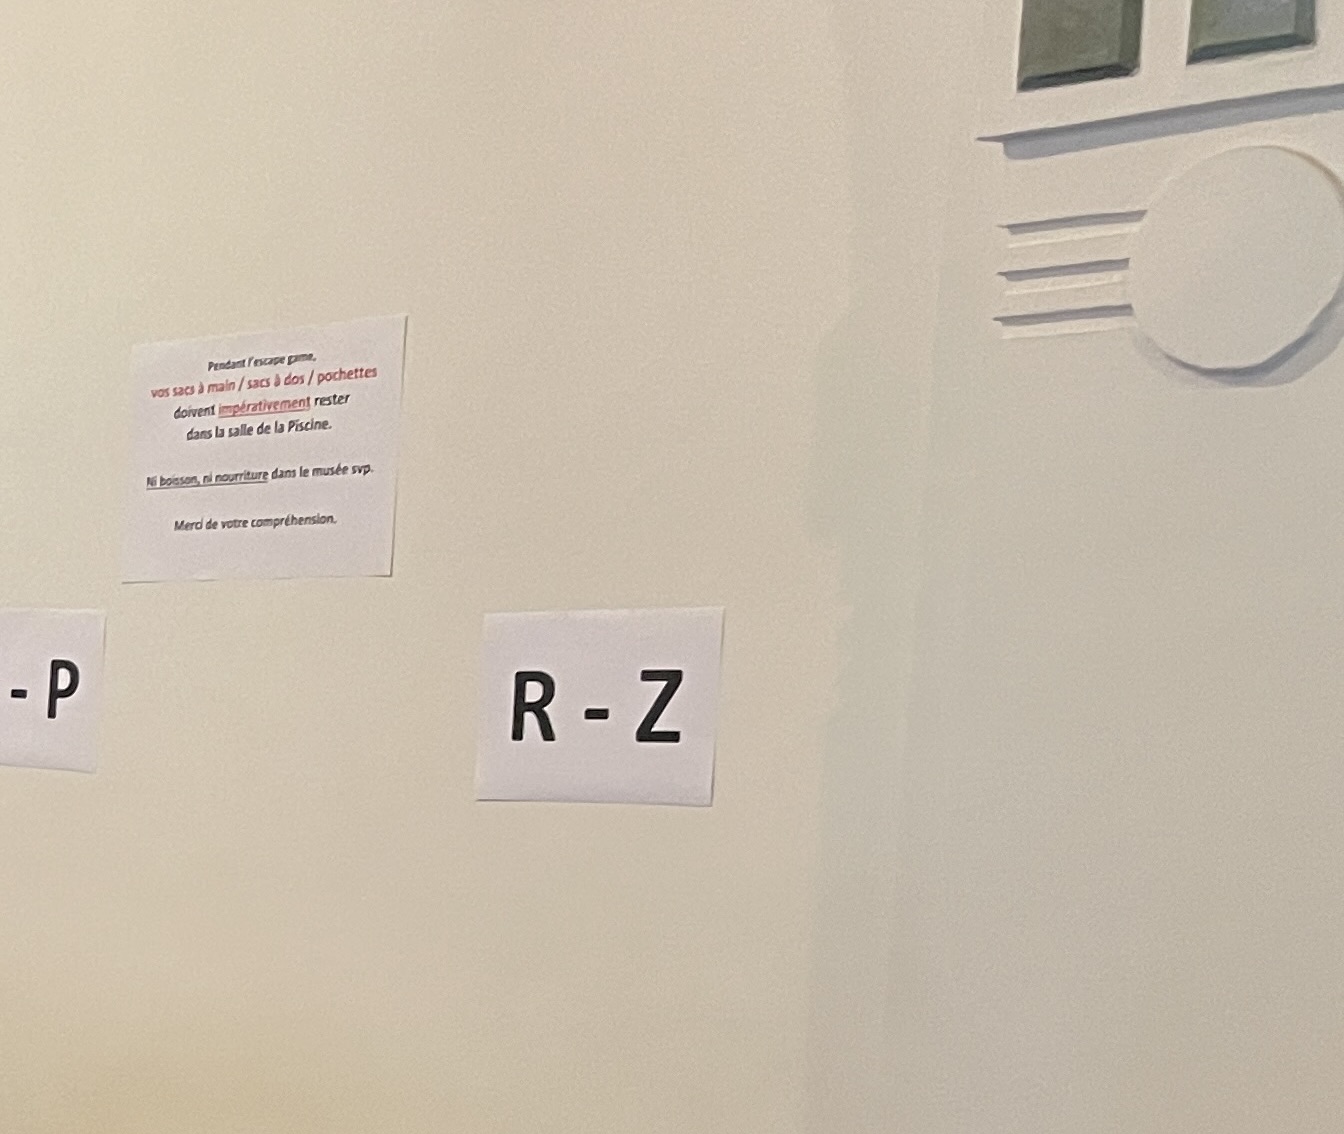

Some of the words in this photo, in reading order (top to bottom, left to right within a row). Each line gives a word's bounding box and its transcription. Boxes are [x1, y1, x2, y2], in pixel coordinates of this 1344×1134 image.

[208, 359, 245, 371] Pendant
[151, 388, 169, 398] vos
[173, 385, 194, 396] sacs
[198, 382, 204, 394] à
[208, 381, 235, 393] main
[247, 378, 270, 390] sacs
[274, 374, 280, 387] à
[285, 374, 304, 386] dos
[317, 367, 377, 384] pochettes
[174, 404, 215, 419] doivent
[219, 396, 310, 416] impérativement
[314, 394, 350, 406] rester
[187, 428, 212, 440] dans
[215, 426, 224, 438] la
[228, 424, 253, 437] salle
[257, 422, 271, 435] de
[274, 421, 284, 433] la
[288, 419, 331, 432] Piscine.
[203, 472, 212, 484] ni
[215, 470, 268, 482] nourriture
[271, 468, 296, 480] dans
[299, 466, 309, 477] le
[312, 463, 348, 476] musée
[174, 520, 203, 530] Merci
[206, 518, 218, 529] de
[221, 518, 248, 529] votre
[251, 513, 337, 529] compréhension.
[47, 659, 80, 719] P
[511, 670, 556, 742] R
[635, 669, 683, 744] Z
